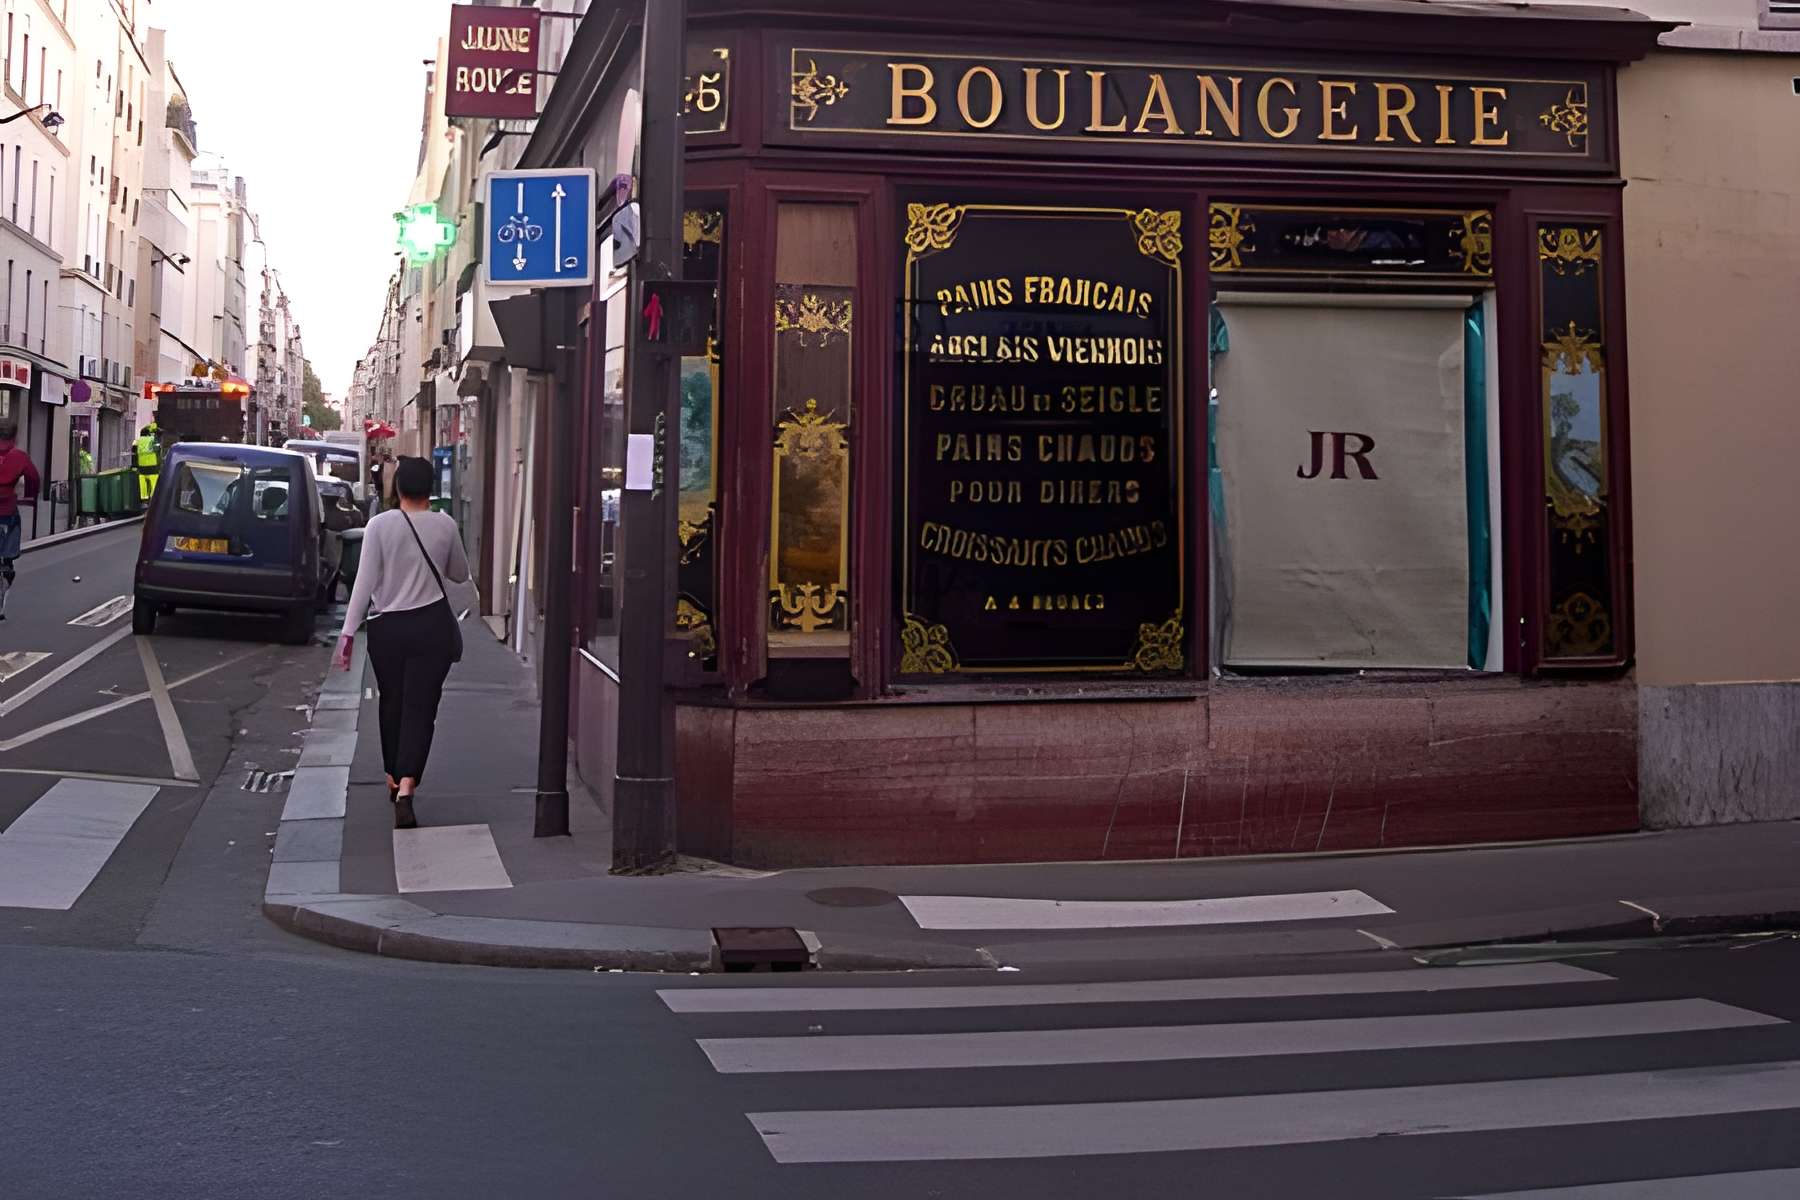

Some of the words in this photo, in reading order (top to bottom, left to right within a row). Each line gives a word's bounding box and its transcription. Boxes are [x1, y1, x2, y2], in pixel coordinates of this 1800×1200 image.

[886, 62, 1509, 146] BOULANGERIE
[1061, 385, 1161, 413] SEIGLE
[936, 433, 1022, 462] PAINS
[1038, 434, 1155, 463] CHAUDS
[1296, 429, 1382, 481] JR
